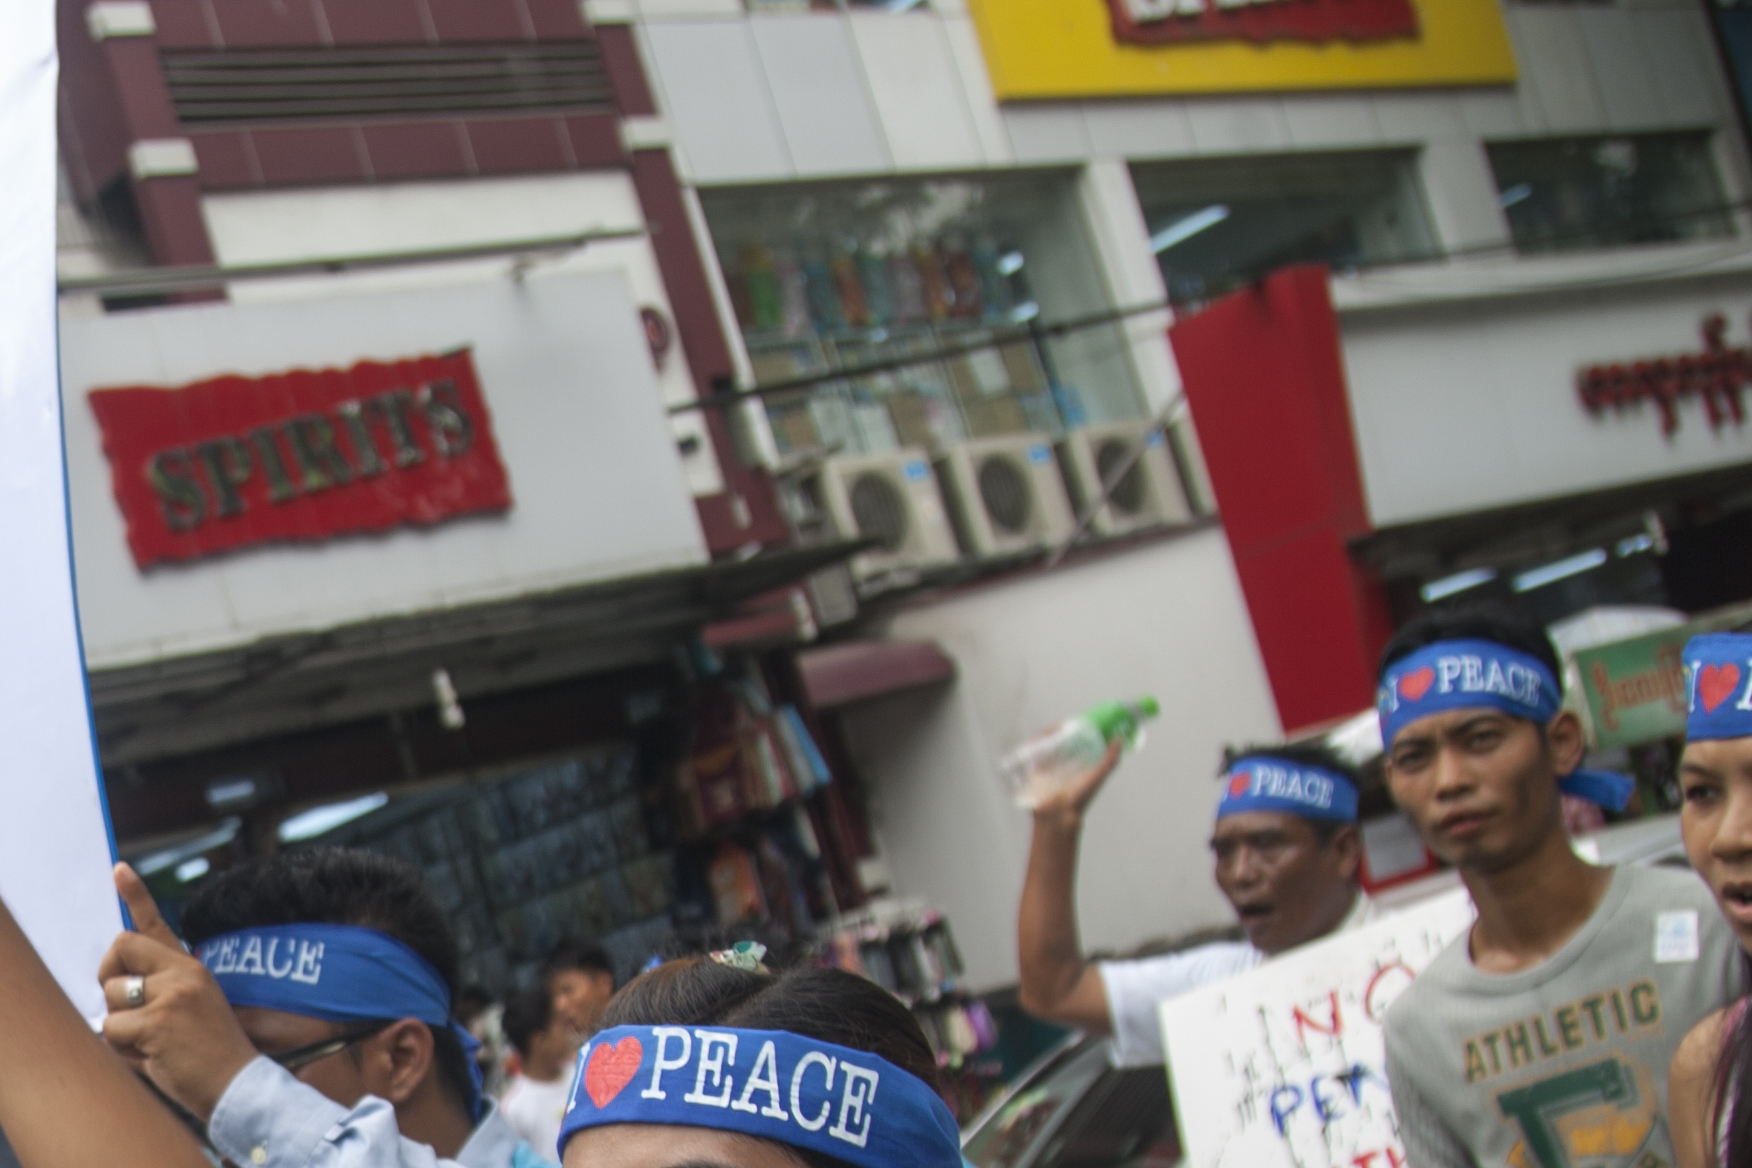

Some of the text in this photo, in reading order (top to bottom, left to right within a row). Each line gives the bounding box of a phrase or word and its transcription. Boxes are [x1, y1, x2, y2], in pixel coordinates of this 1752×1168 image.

[147, 377, 477, 533] SPIRITS
[1437, 655, 1543, 707] PEACE
[1251, 763, 1336, 810] PEACE
[1463, 980, 1663, 1085] ATHLETIC
[640, 1025, 880, 1149] PEACE
